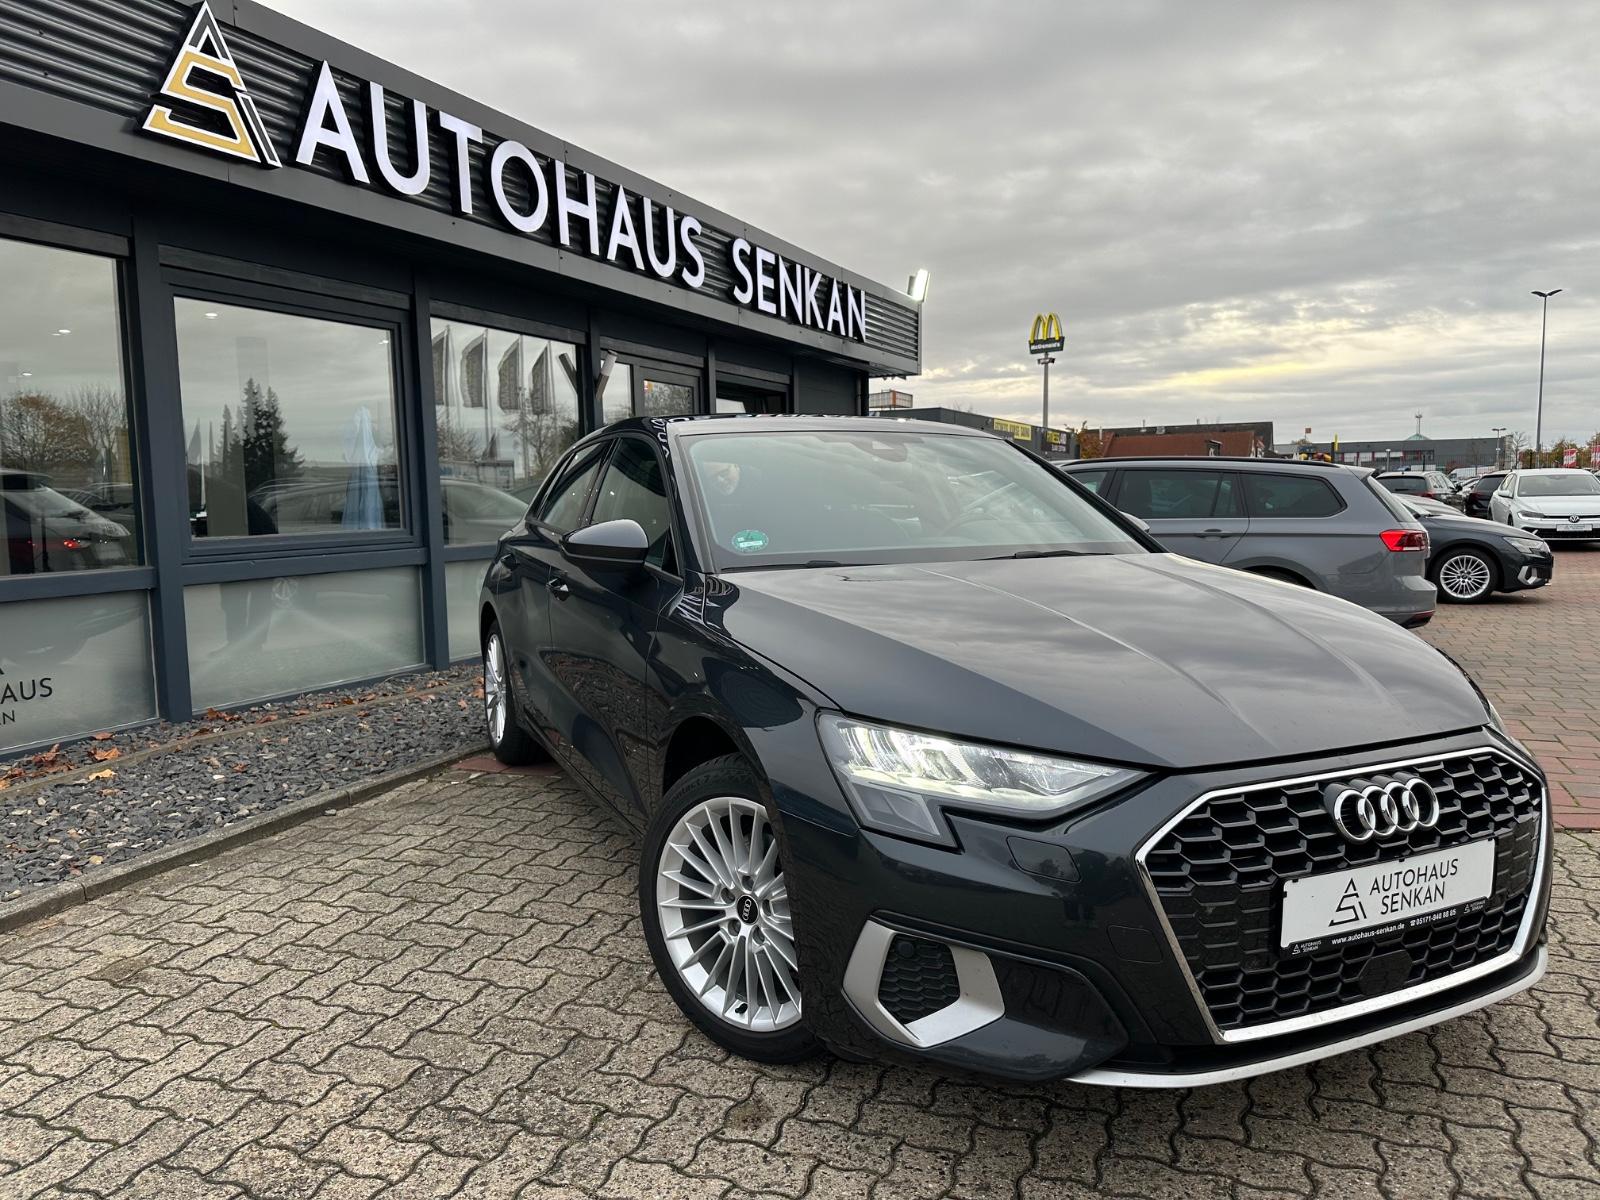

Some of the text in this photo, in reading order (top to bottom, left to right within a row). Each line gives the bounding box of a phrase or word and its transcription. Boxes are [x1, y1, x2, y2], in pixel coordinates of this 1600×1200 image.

[296, 61, 867, 343] AUTOHAUS SENKAN
[1369, 858, 1459, 896] AUTOHAUS
[1380, 881, 1446, 915] SENKAN
[1331, 923, 1405, 945] www.autohaus-senkan.de
